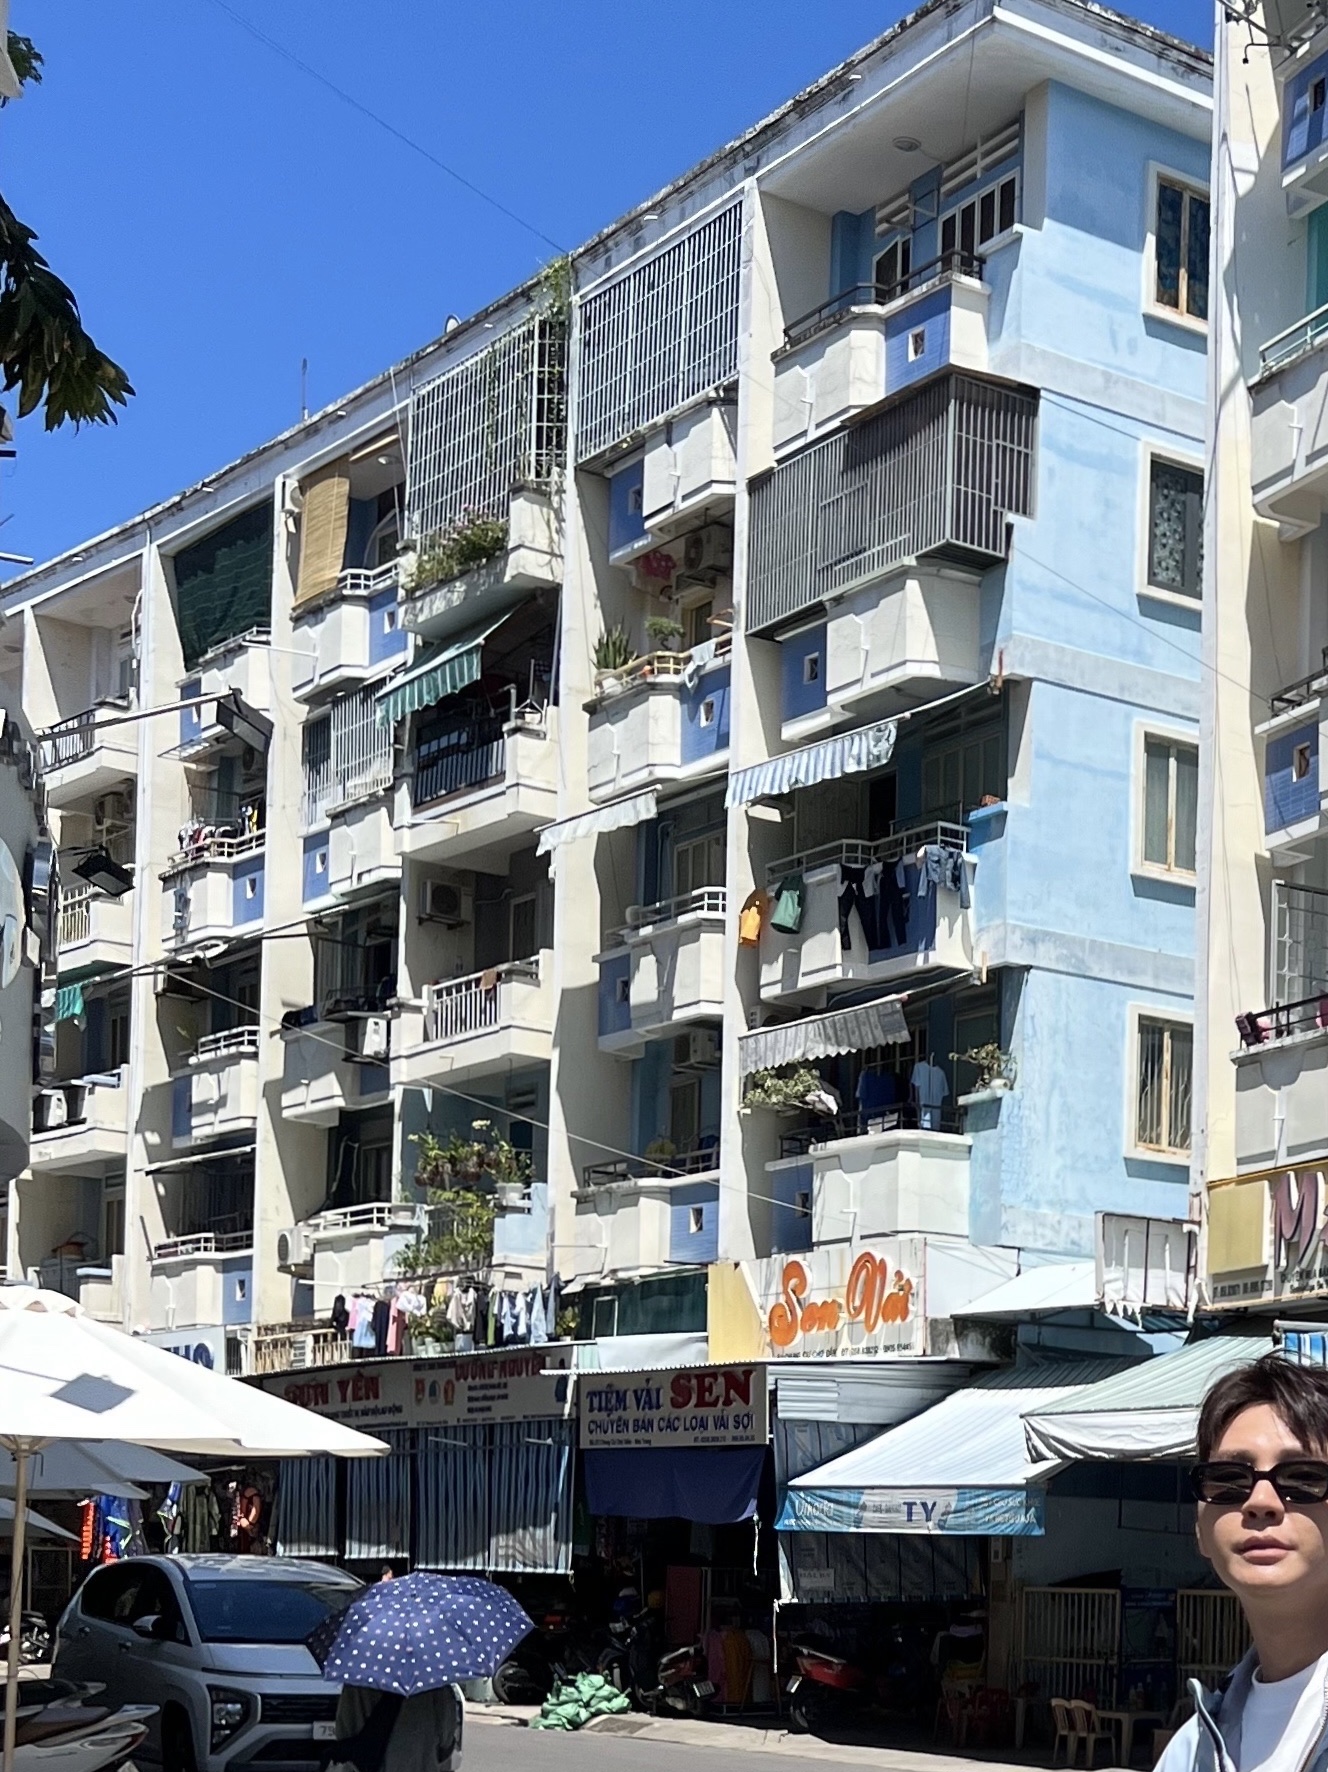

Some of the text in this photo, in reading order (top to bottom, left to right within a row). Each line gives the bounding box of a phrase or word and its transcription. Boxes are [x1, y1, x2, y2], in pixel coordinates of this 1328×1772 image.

[586, 1378, 663, 1418] TIỆM VẢI
[670, 1370, 753, 1410] SEN
[587, 1414, 629, 1435] CHUYÊN
[632, 1413, 654, 1433] BÁN
[657, 1413, 680, 1432] CÁC
[682, 1413, 708, 1435] LOẠI
[712, 1409, 729, 1430] VẢI
[733, 1412, 753, 1434] SỢI
[903, 1501, 937, 1522] TY
